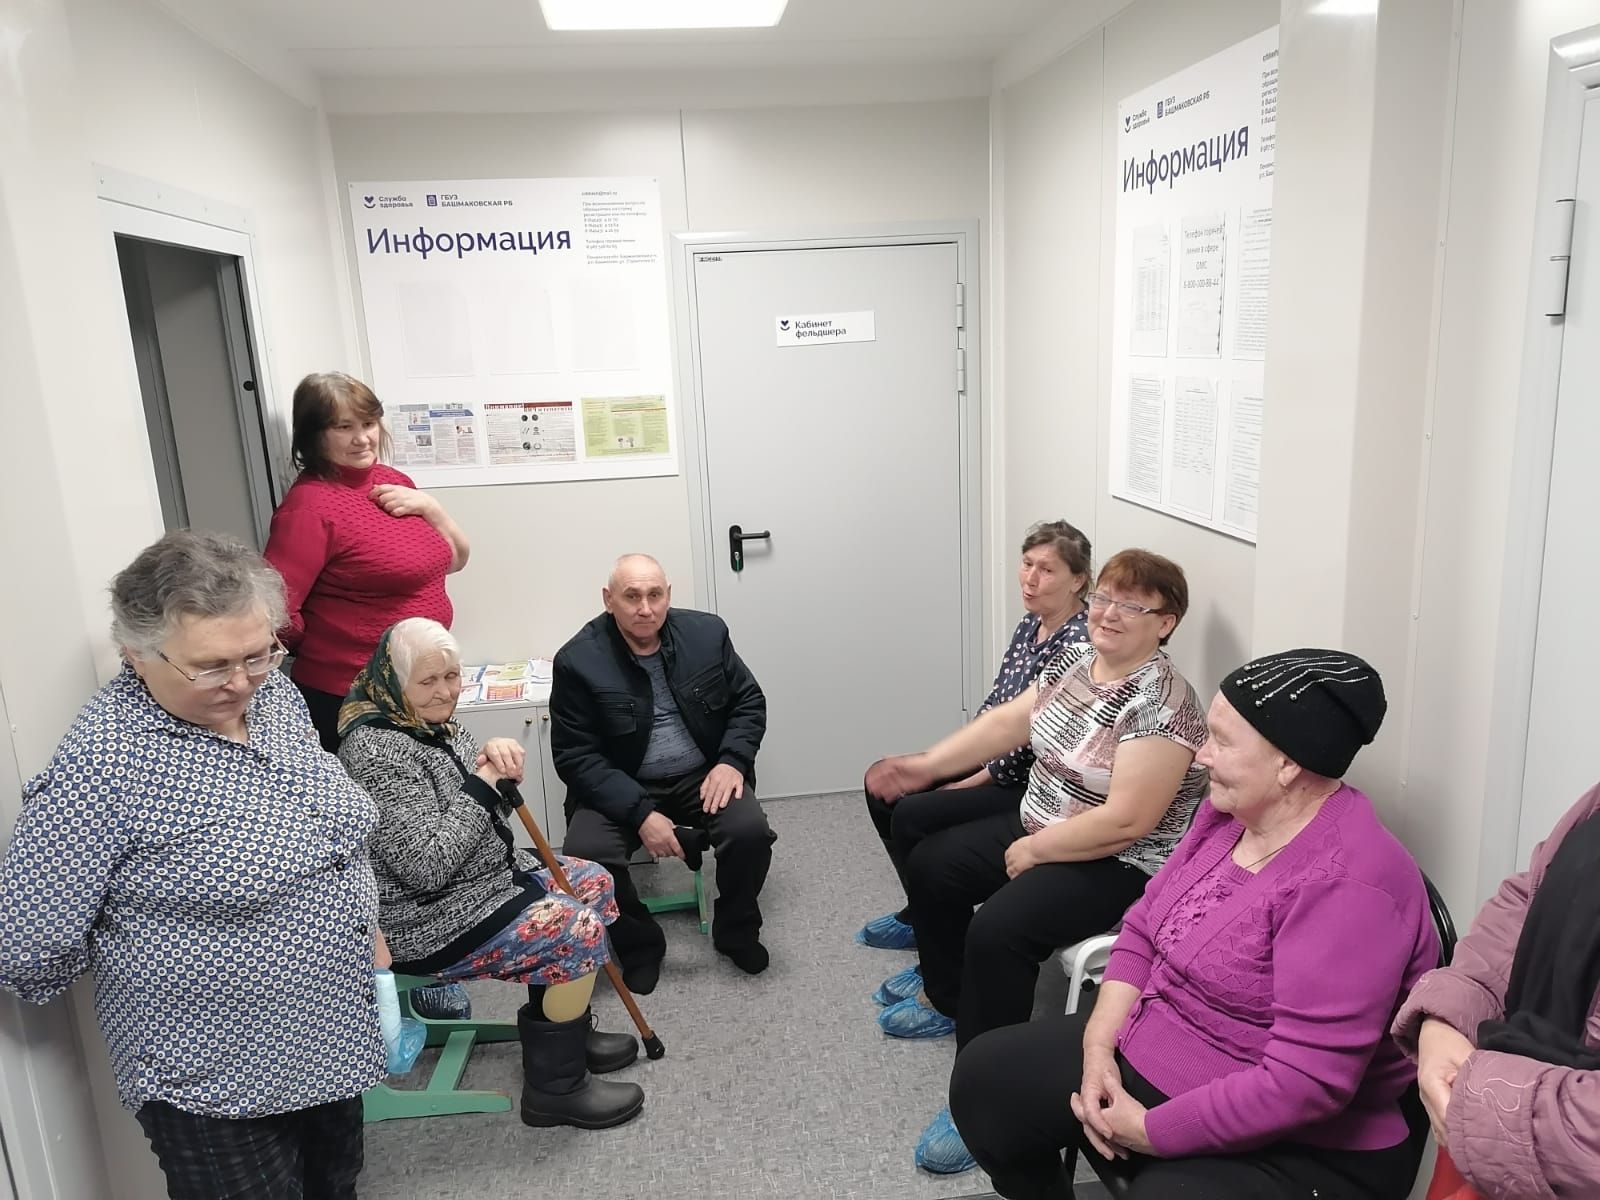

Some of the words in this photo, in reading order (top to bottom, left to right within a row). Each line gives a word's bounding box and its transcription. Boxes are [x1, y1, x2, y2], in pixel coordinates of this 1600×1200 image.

[1123, 125, 1249, 195] Информация
[378, 195, 407, 203] Служба
[440, 193, 459, 201] ГБУЗ
[441, 199, 503, 208] БАШМАКОВСКАЯ
[366, 226, 572, 260] Информация
[795, 320, 833, 330] Кабинет
[795, 327, 847, 339] фельдшера
